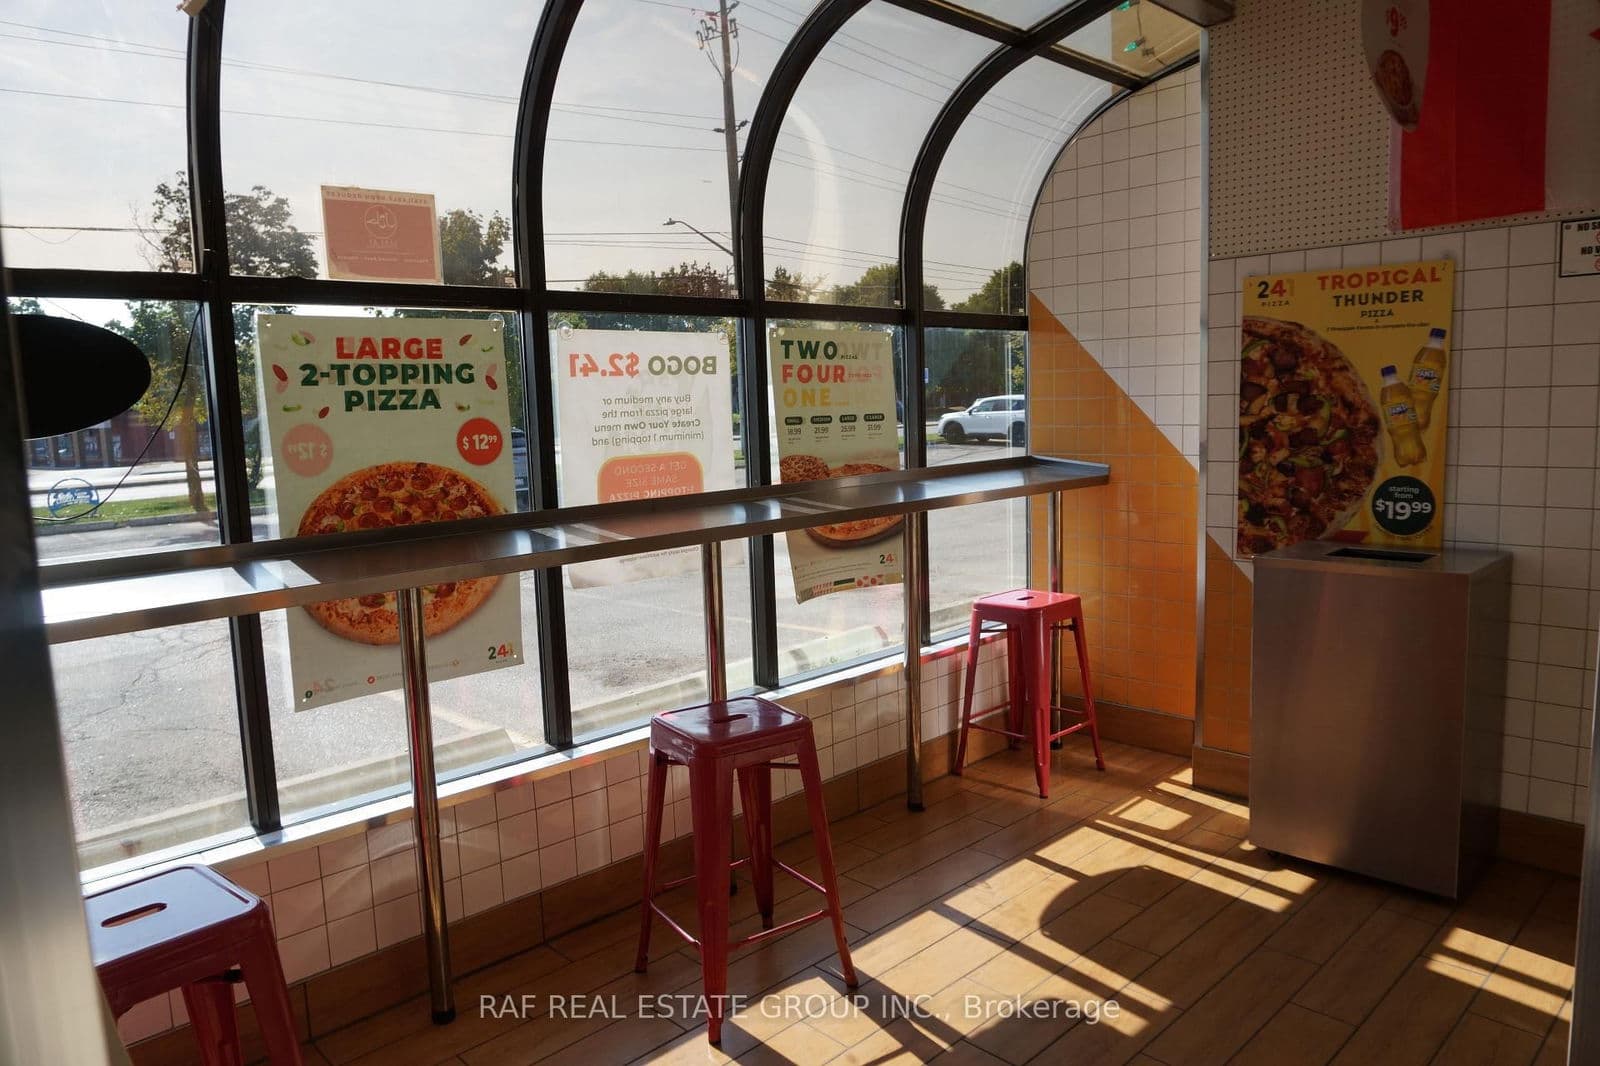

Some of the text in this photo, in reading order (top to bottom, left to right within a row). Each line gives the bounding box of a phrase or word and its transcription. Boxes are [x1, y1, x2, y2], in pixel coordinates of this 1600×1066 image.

[1577, 223, 1590, 232] NO
[1581, 246, 1593, 255] NO
[1317, 266, 1442, 291] TROPICAL
[1333, 289, 1424, 307] THUNDER
[1360, 310, 1394, 318] PIZZA
[335, 336, 443, 360] LARGE
[780, 340, 838, 360] TWO
[299, 362, 475, 387] 2-TOPPING
[781, 364, 846, 384] FOUR
[344, 388, 442, 412] PIZZA
[783, 387, 832, 409] ONE
[1389, 486, 1419, 494] starting
